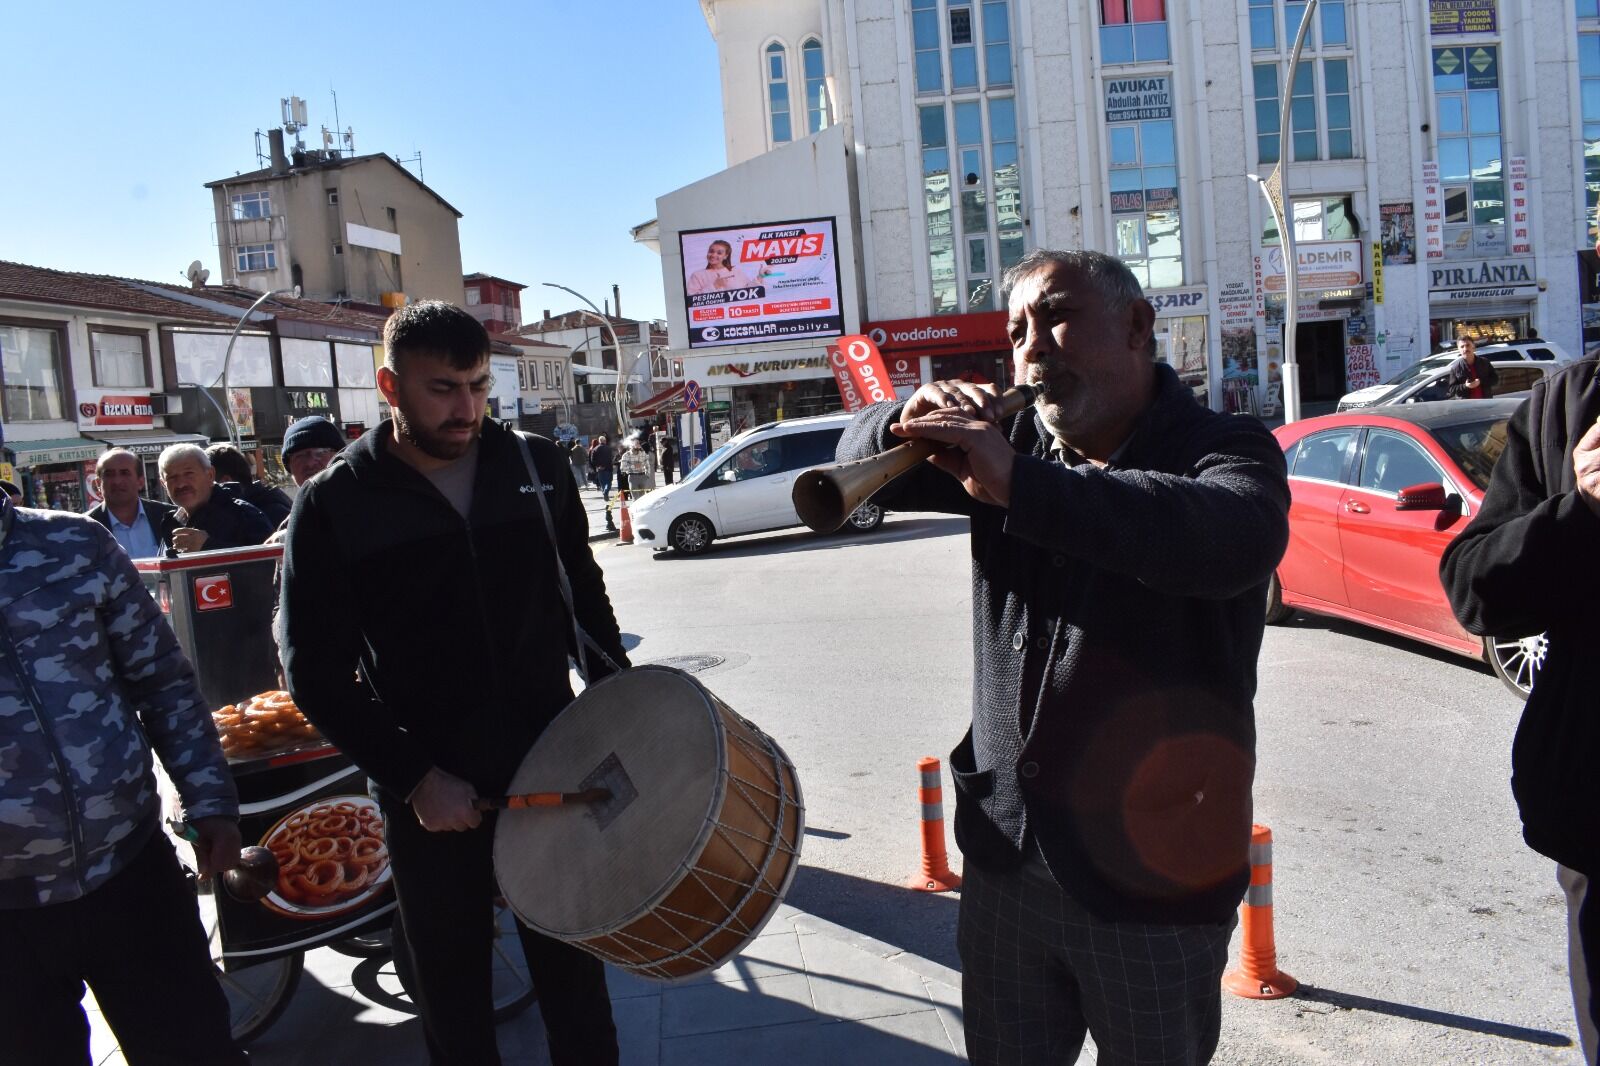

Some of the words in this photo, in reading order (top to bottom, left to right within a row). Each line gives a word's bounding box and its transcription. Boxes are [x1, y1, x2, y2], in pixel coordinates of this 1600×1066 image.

[1109, 79, 1165, 94] AVUKAT
[1107, 95, 1141, 109] Abdullah
[1143, 92, 1168, 106] AKYÜZ
[1111, 193, 1142, 211] PALAS
[746, 236, 818, 259] MAYIS
[1432, 262, 1531, 287] PIRLANTA
[727, 287, 760, 301] YOK
[729, 307, 743, 317] 10
[779, 323, 829, 332] mobilya
[891, 327, 958, 342] vodafone
[104, 402, 132, 416] ÖZCAN
[134, 403, 153, 415] GIDA
[128, 444, 161, 453] ÖZCAN
